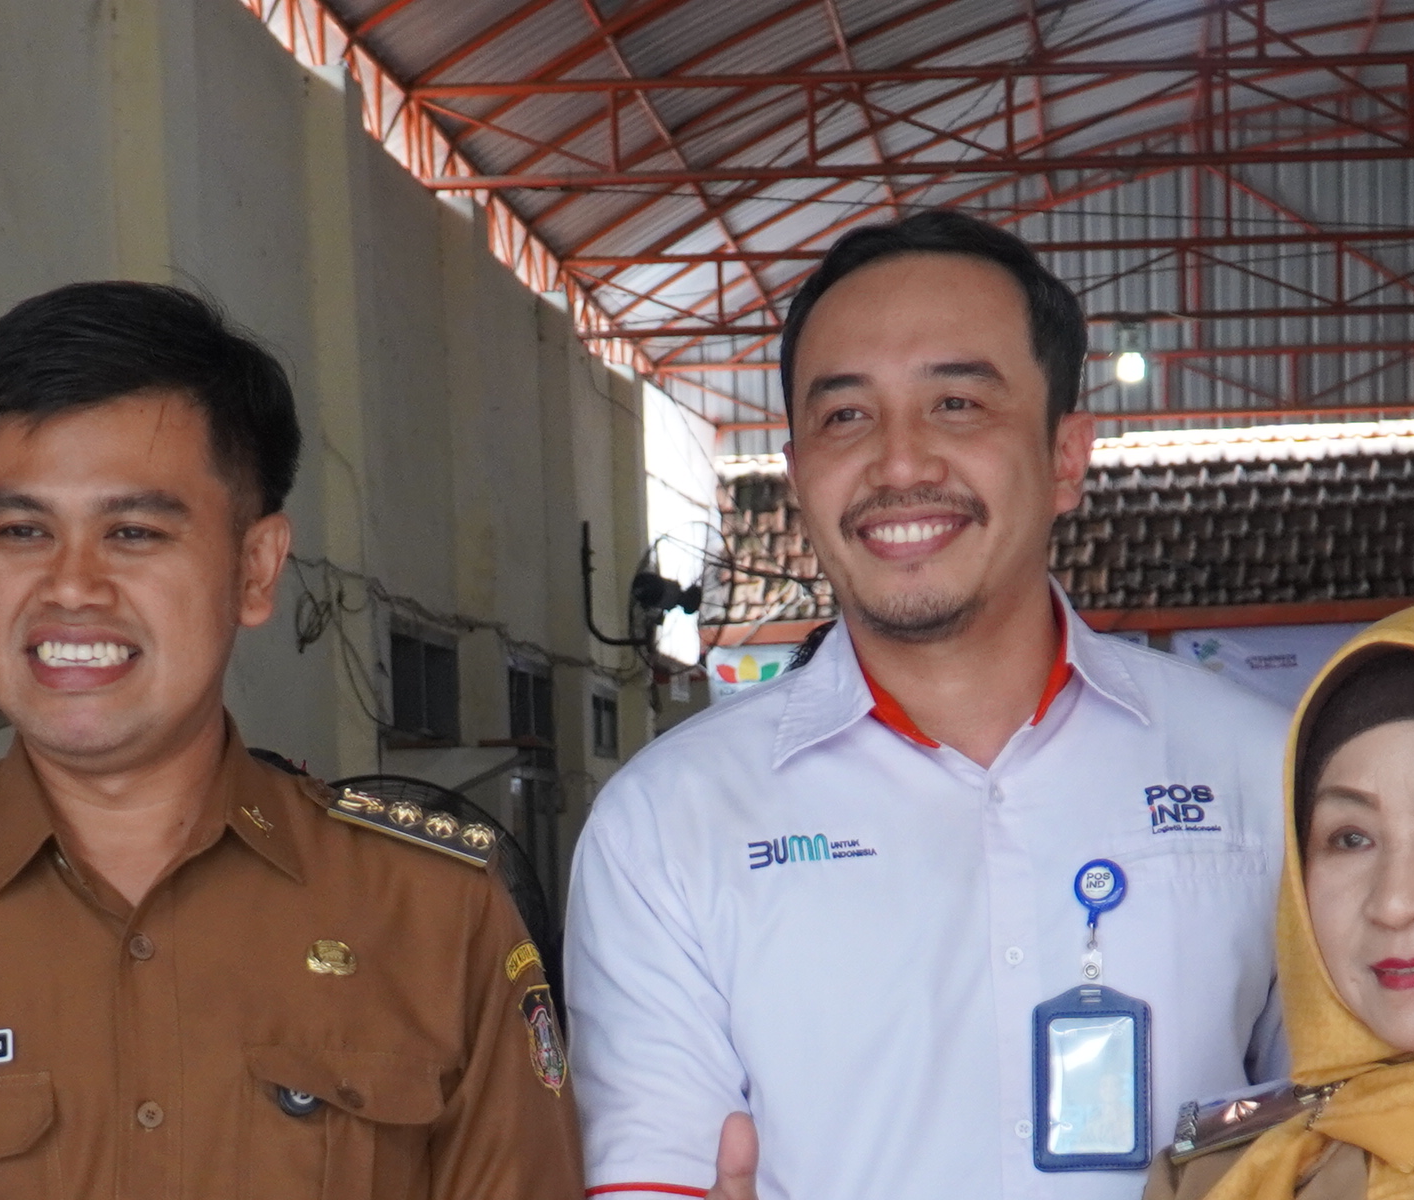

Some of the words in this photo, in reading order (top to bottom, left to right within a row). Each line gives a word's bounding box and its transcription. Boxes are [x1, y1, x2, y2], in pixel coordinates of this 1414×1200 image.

[1145, 784, 1214, 804] POS
[830, 839, 860, 849] UNTUK
[832, 848, 877, 859] INDONESIA
[1086, 872, 1110, 880] POS
